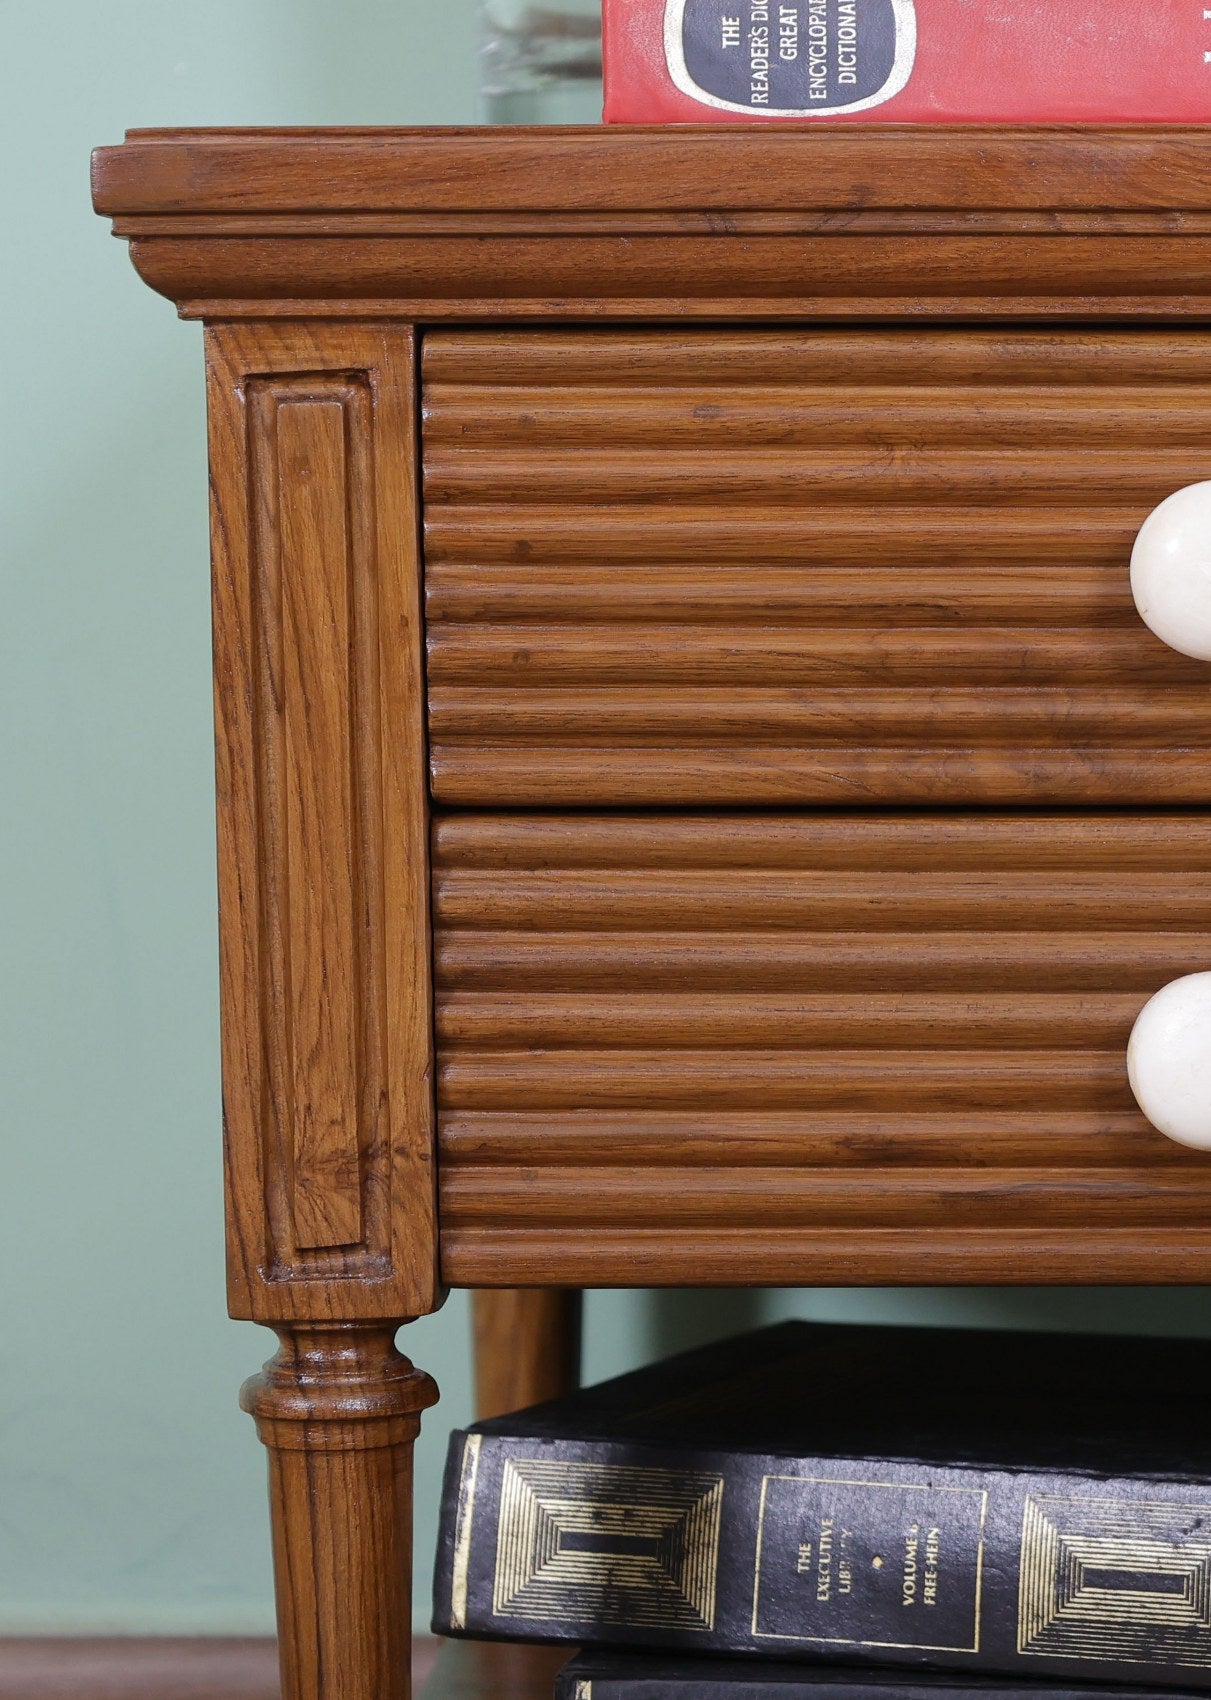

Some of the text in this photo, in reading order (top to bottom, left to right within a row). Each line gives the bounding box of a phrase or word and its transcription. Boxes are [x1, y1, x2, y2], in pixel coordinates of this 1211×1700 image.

[722, 15, 740, 49] THE
[747, 26, 769, 104] READER'S
[780, 5, 798, 60] GREAT
[838, 0, 856, 84] DICTIONA
[797, 1542, 812, 1574] THE
[816, 1518, 834, 1601] EXECUTIVE
[902, 1537, 918, 1606] VOLUME
